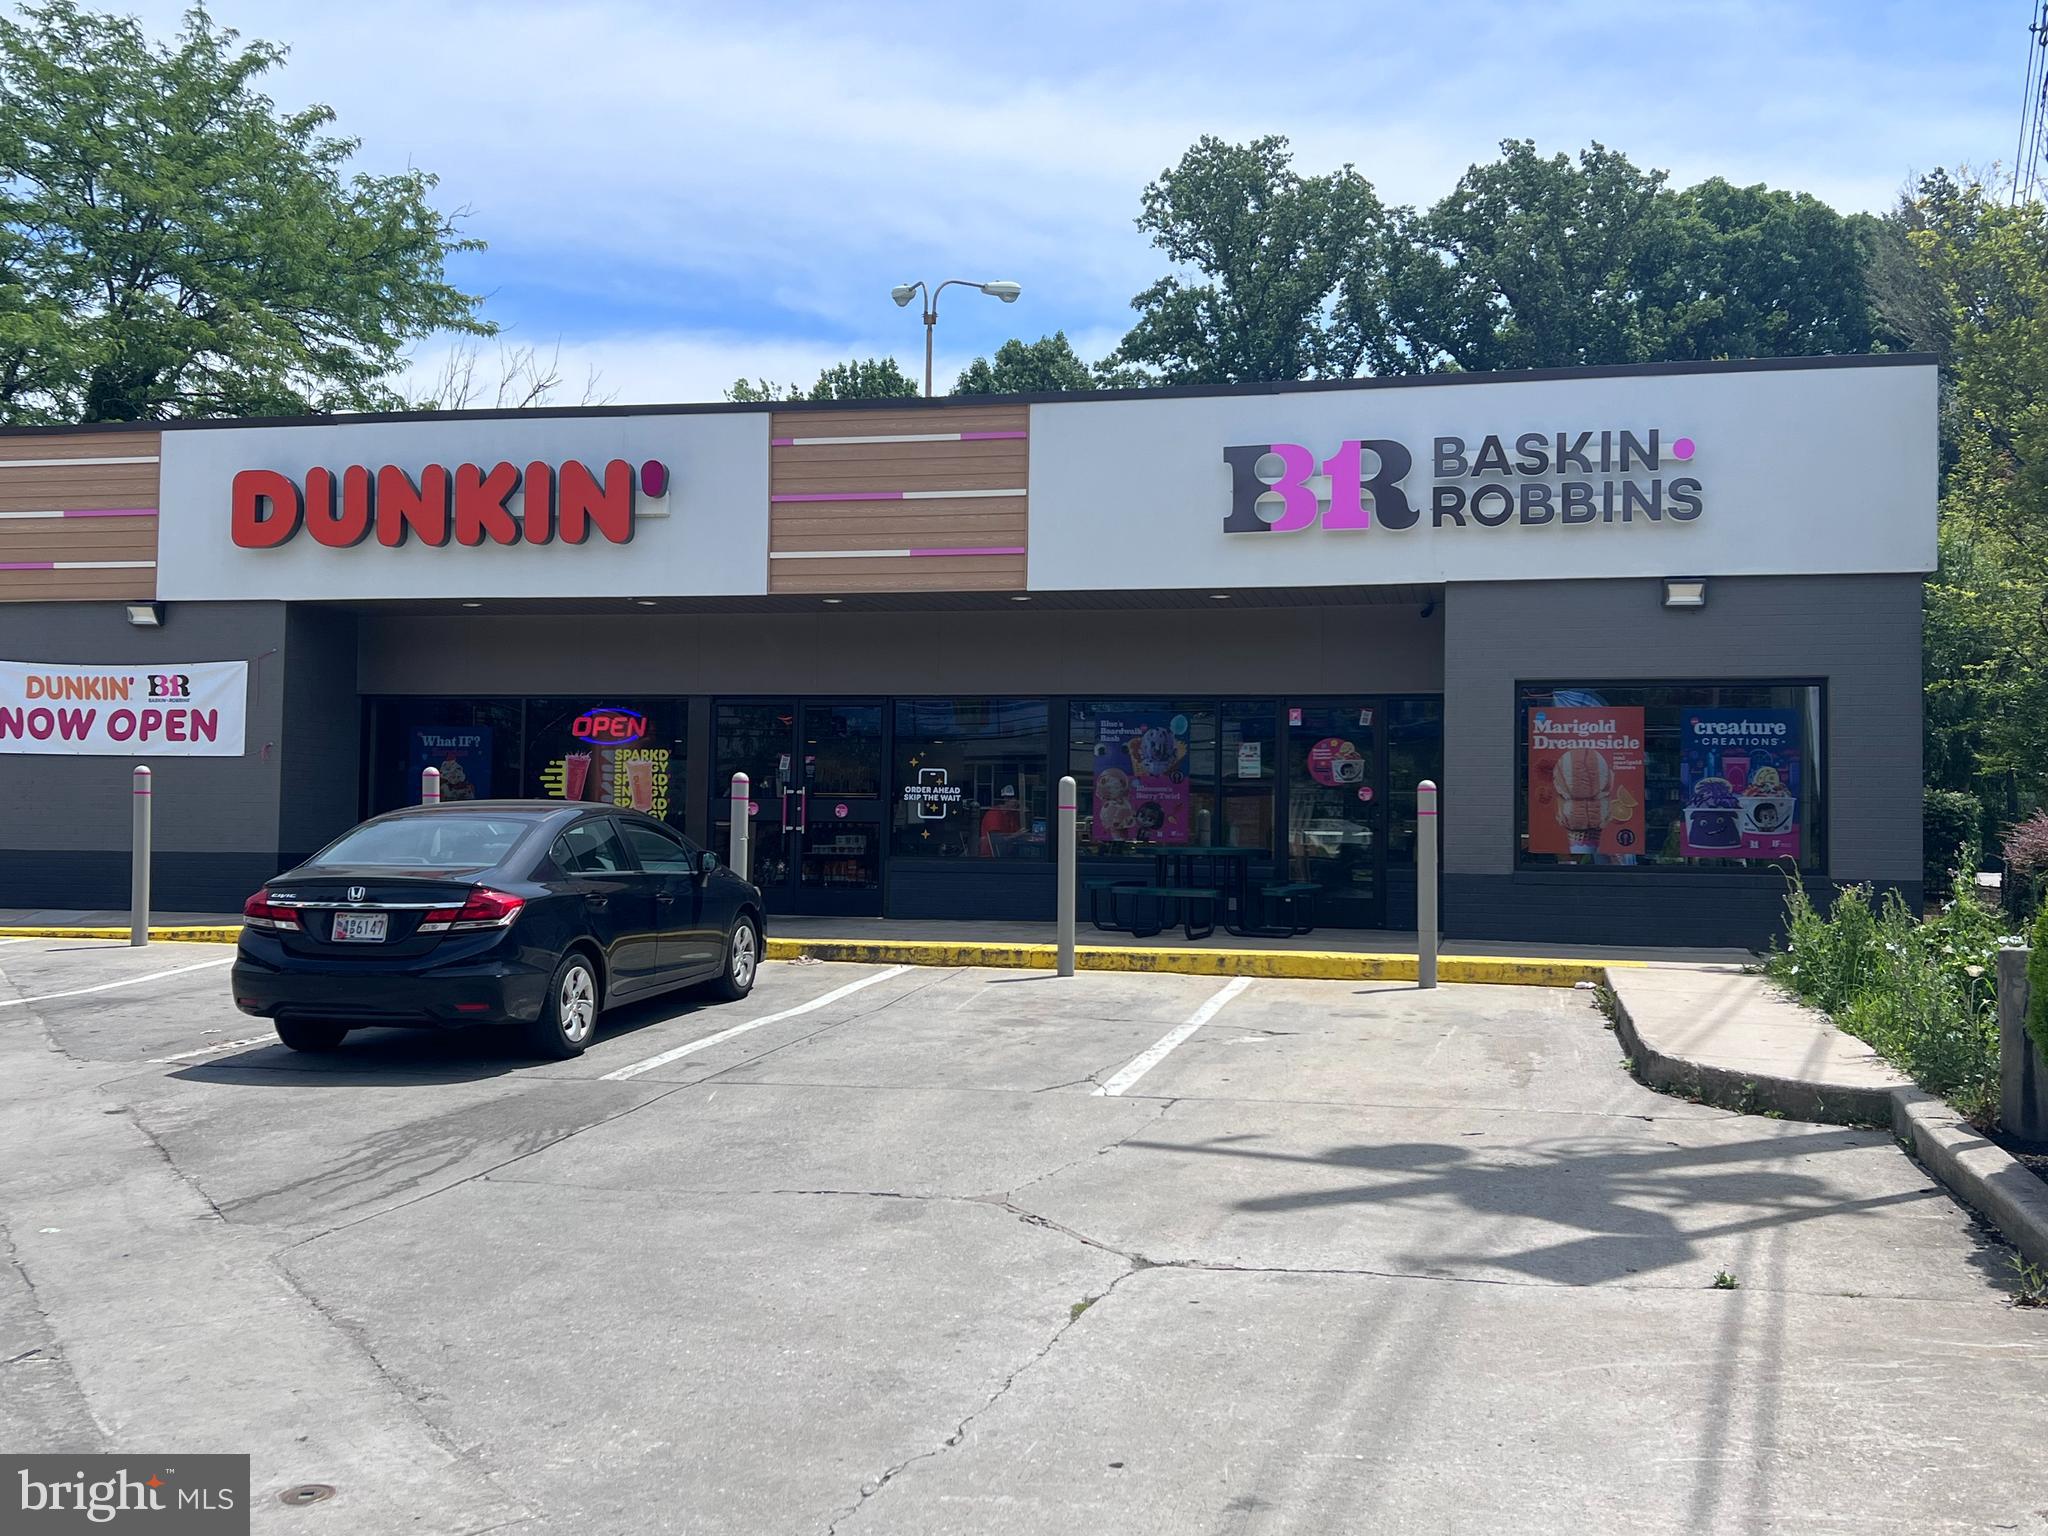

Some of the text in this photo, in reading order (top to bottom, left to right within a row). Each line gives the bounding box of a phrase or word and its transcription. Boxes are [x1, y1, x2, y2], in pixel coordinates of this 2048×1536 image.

[232, 459, 669, 549] DUNKIN'
[1432, 477, 1704, 528] ROBBINS
[26, 675, 134, 700] DUNKIN'
[0, 707, 218, 742] NOW OPEN
[572, 716, 648, 737] OPEN
[1533, 719, 1616, 736] Marigold
[1694, 719, 1786, 735] creature
[421, 735, 481, 748] What IF?
[1533, 735, 1640, 749] Dreamsicle
[905, 786, 960, 794] ORDER AHEAD
[940, 794, 961, 802] WAIT
